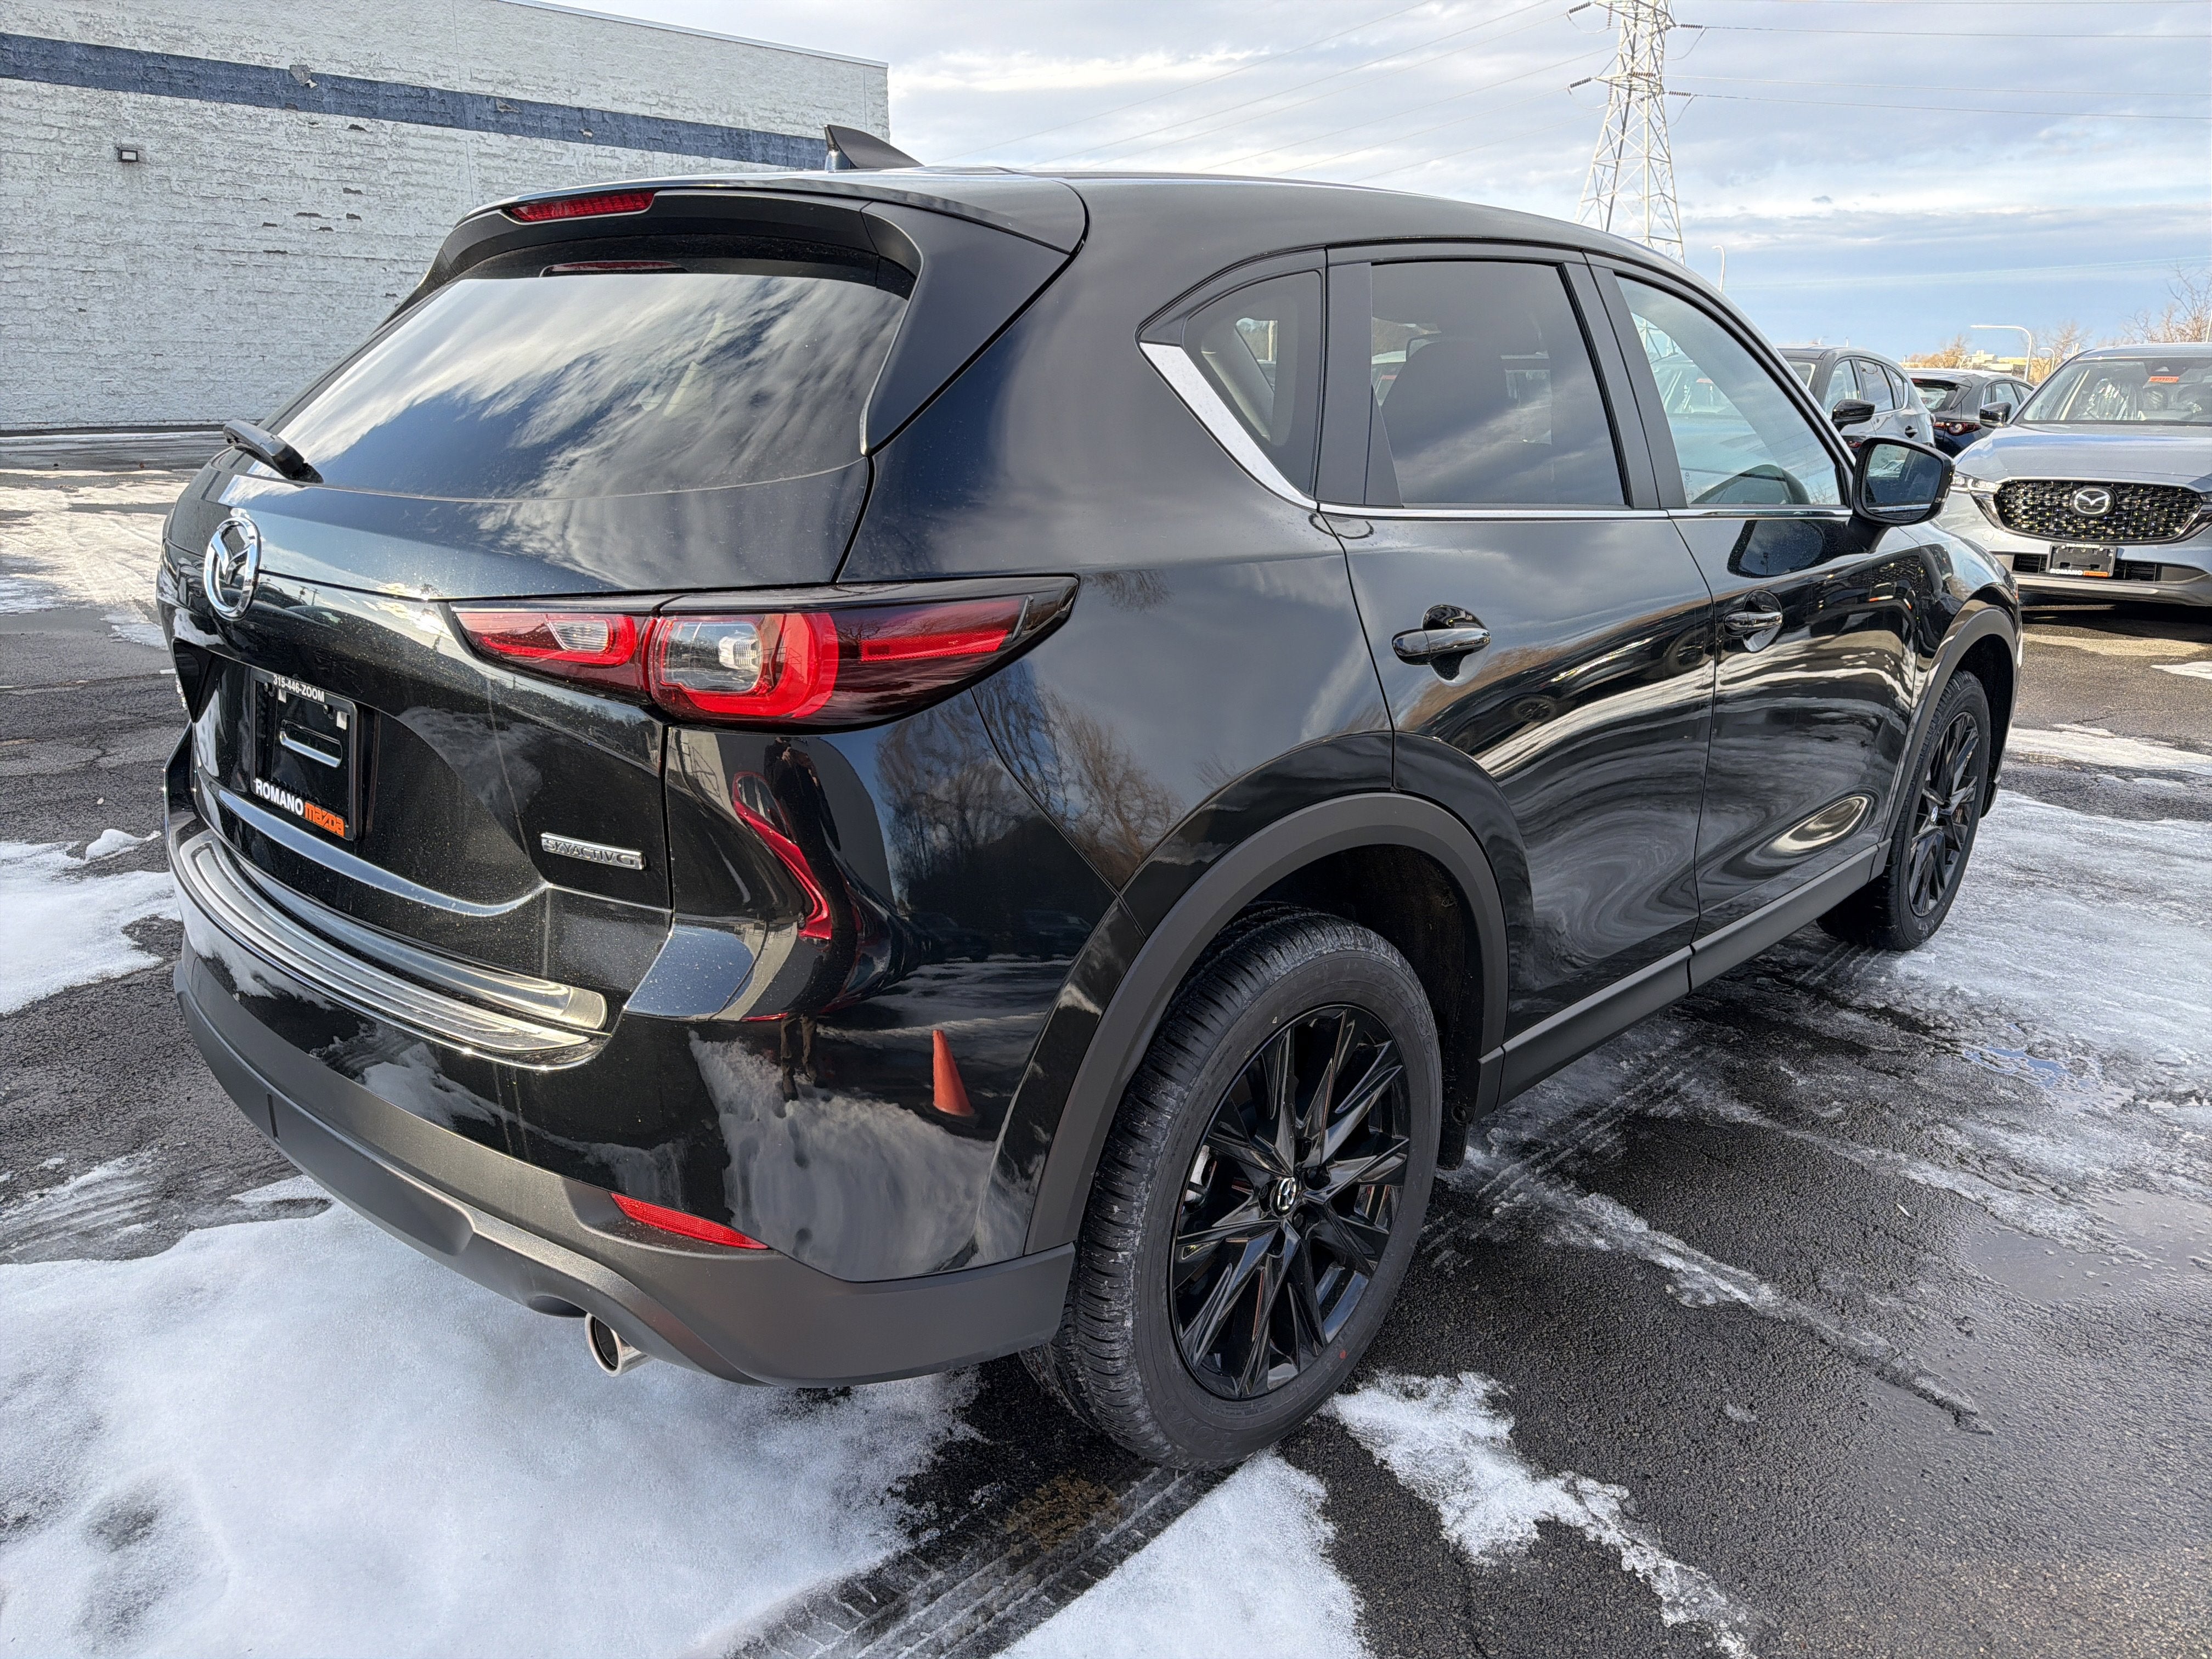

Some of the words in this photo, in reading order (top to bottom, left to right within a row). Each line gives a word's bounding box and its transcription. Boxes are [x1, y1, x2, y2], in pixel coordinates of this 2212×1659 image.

[273, 674, 325, 703] 315-446-ZOOM
[255, 777, 303, 816] ROMANO
[304, 802, 345, 837] mazda
